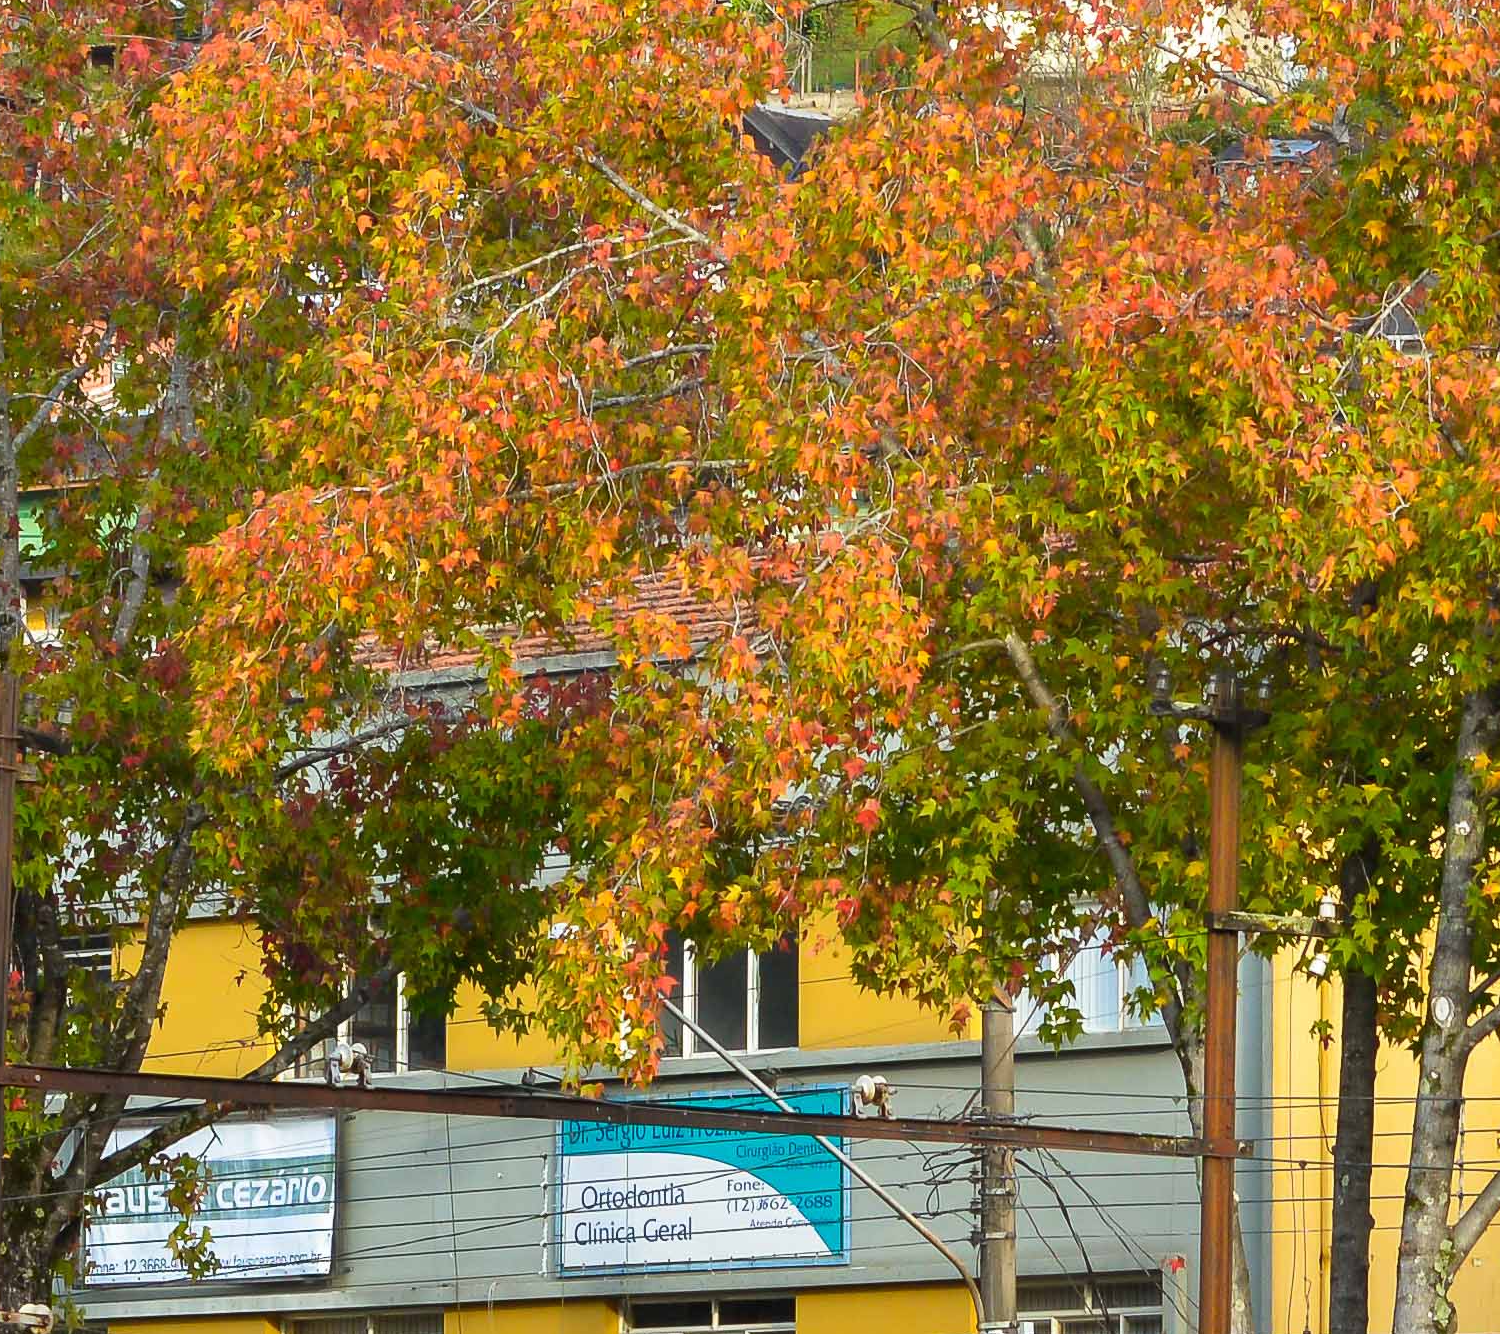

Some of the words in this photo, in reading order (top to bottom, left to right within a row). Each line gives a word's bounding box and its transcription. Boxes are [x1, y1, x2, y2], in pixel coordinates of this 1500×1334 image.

[788, 1140, 830, 1157] Dentis
[215, 1167, 327, 1210] cezário
[580, 1183, 686, 1211] Ortodontia
[726, 1178, 766, 1193] Fone:
[574, 1218, 638, 1248] Clínica
[642, 1216, 693, 1244] Geral
